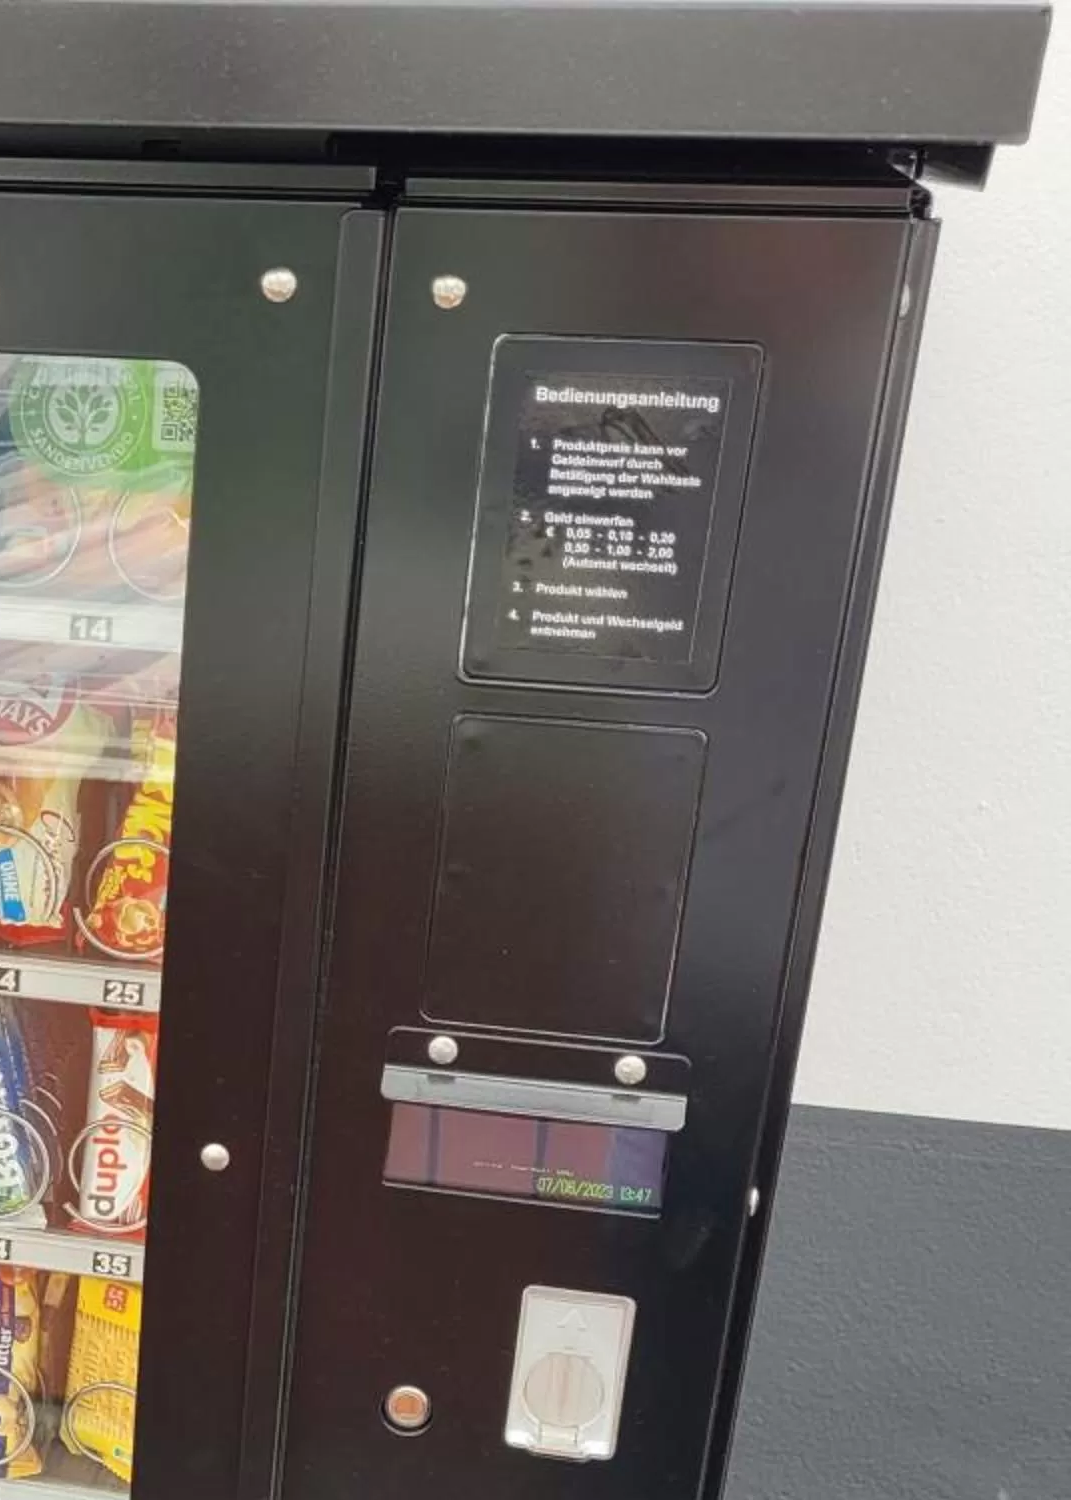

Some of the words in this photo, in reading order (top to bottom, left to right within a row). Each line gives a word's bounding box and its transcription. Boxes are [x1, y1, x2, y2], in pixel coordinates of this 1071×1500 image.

[535, 386, 720, 413] Bedienungsanleitung
[632, 444, 664, 455] kann
[551, 454, 626, 468] Geldeinwurf
[628, 458, 663, 470] durch
[550, 468, 615, 484] Betätigung
[618, 473, 639, 484] der
[547, 484, 606, 498] angezeigt
[608, 487, 654, 499] werden
[544, 511, 573, 524] Geld
[575, 514, 634, 528] einwerfen
[562, 556, 619, 571] (Automat
[536, 583, 583, 597] Produkt
[585, 586, 628, 600] wählen
[74, 619, 110, 640] 14
[532, 611, 579, 625] Produkt
[581, 614, 604, 627] und
[607, 616, 684, 631] Wechselgeld
[530, 627, 596, 640] entnehmen
[107, 982, 141, 1003] 25
[88, 1114, 128, 1217] duplo
[95, 1253, 129, 1274] 35
